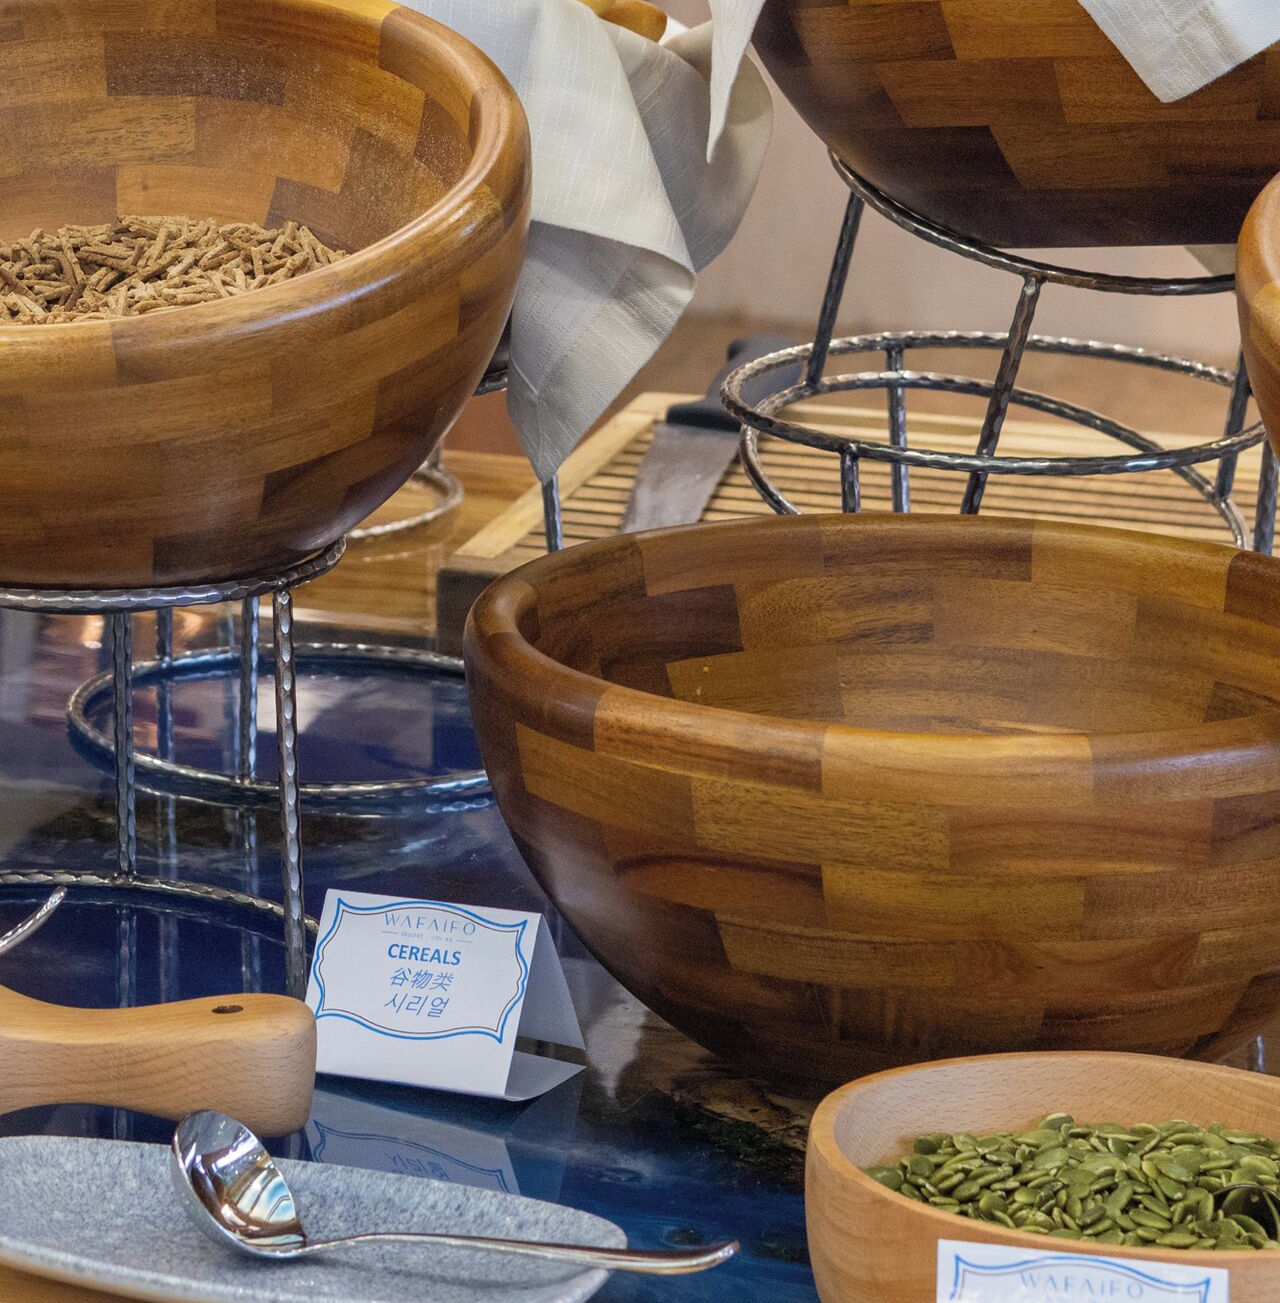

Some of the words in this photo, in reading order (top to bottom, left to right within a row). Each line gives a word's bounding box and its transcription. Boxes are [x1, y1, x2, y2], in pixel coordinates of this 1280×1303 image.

[384, 912, 476, 936] WAFAIFO
[387, 943, 462, 966] CEREALS
[390, 967, 455, 992] 谷物类
[384, 992, 450, 1018] 시리얼
